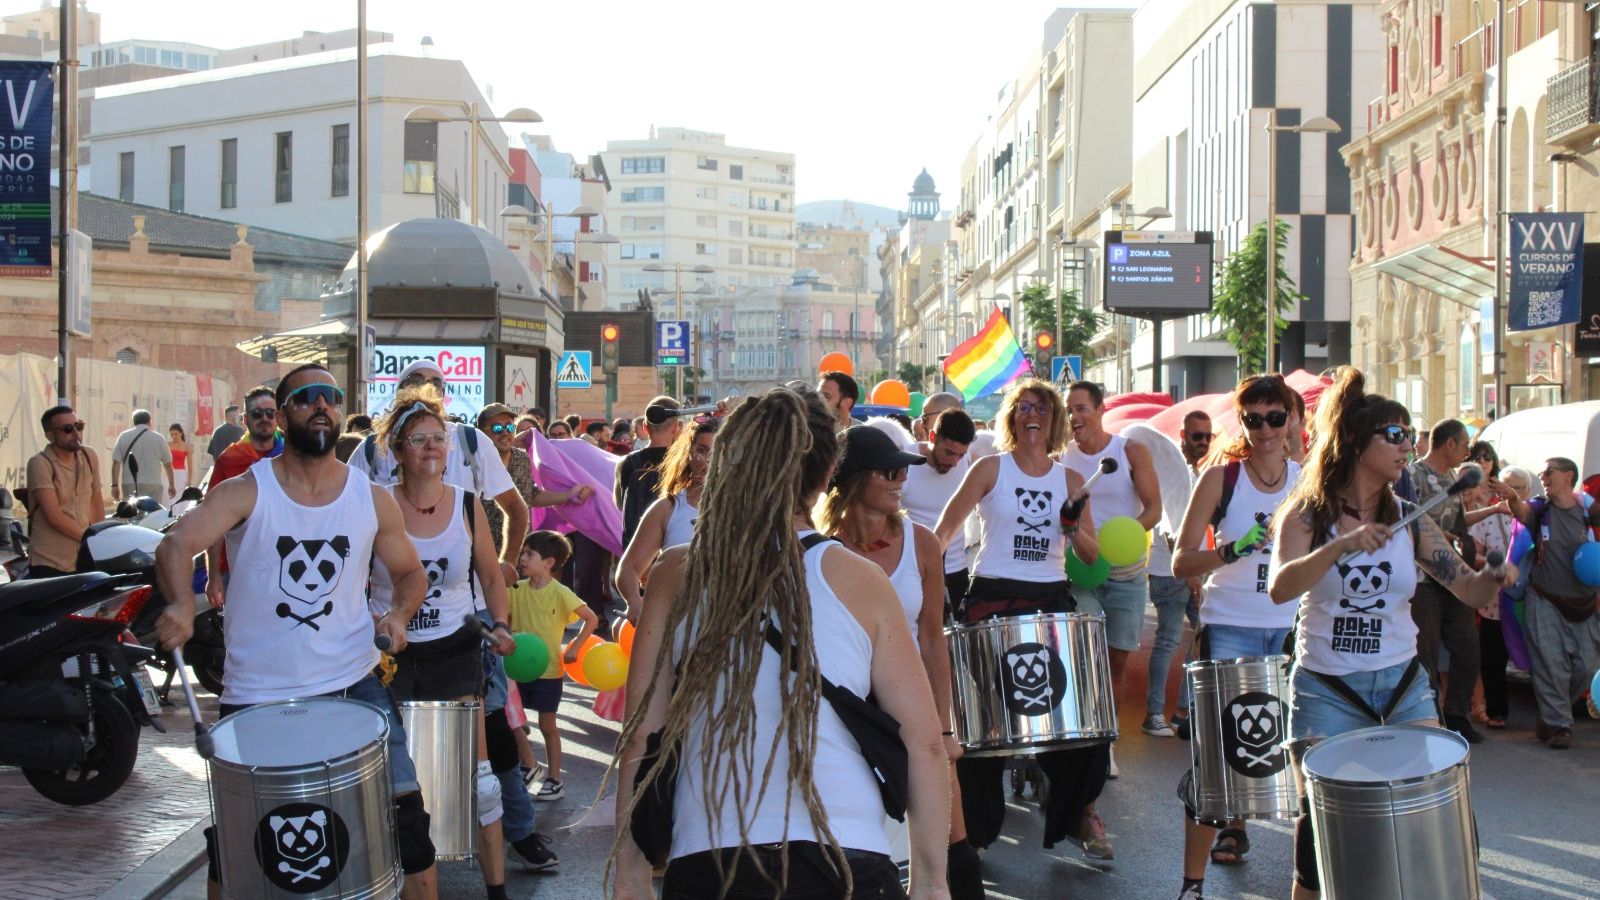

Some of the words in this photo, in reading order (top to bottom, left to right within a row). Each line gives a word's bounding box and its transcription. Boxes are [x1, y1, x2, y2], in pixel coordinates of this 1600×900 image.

[0, 79, 37, 131] V
[11, 135, 35, 150] DE
[1518, 222, 1576, 251] XXV
[1519, 253, 1561, 262] CURSOS
[1562, 254, 1576, 263] DE
[1519, 262, 1576, 274] VERANO
[375, 350, 482, 376] DamCan
[369, 383, 397, 394] HOT
[446, 383, 482, 395] NINO
